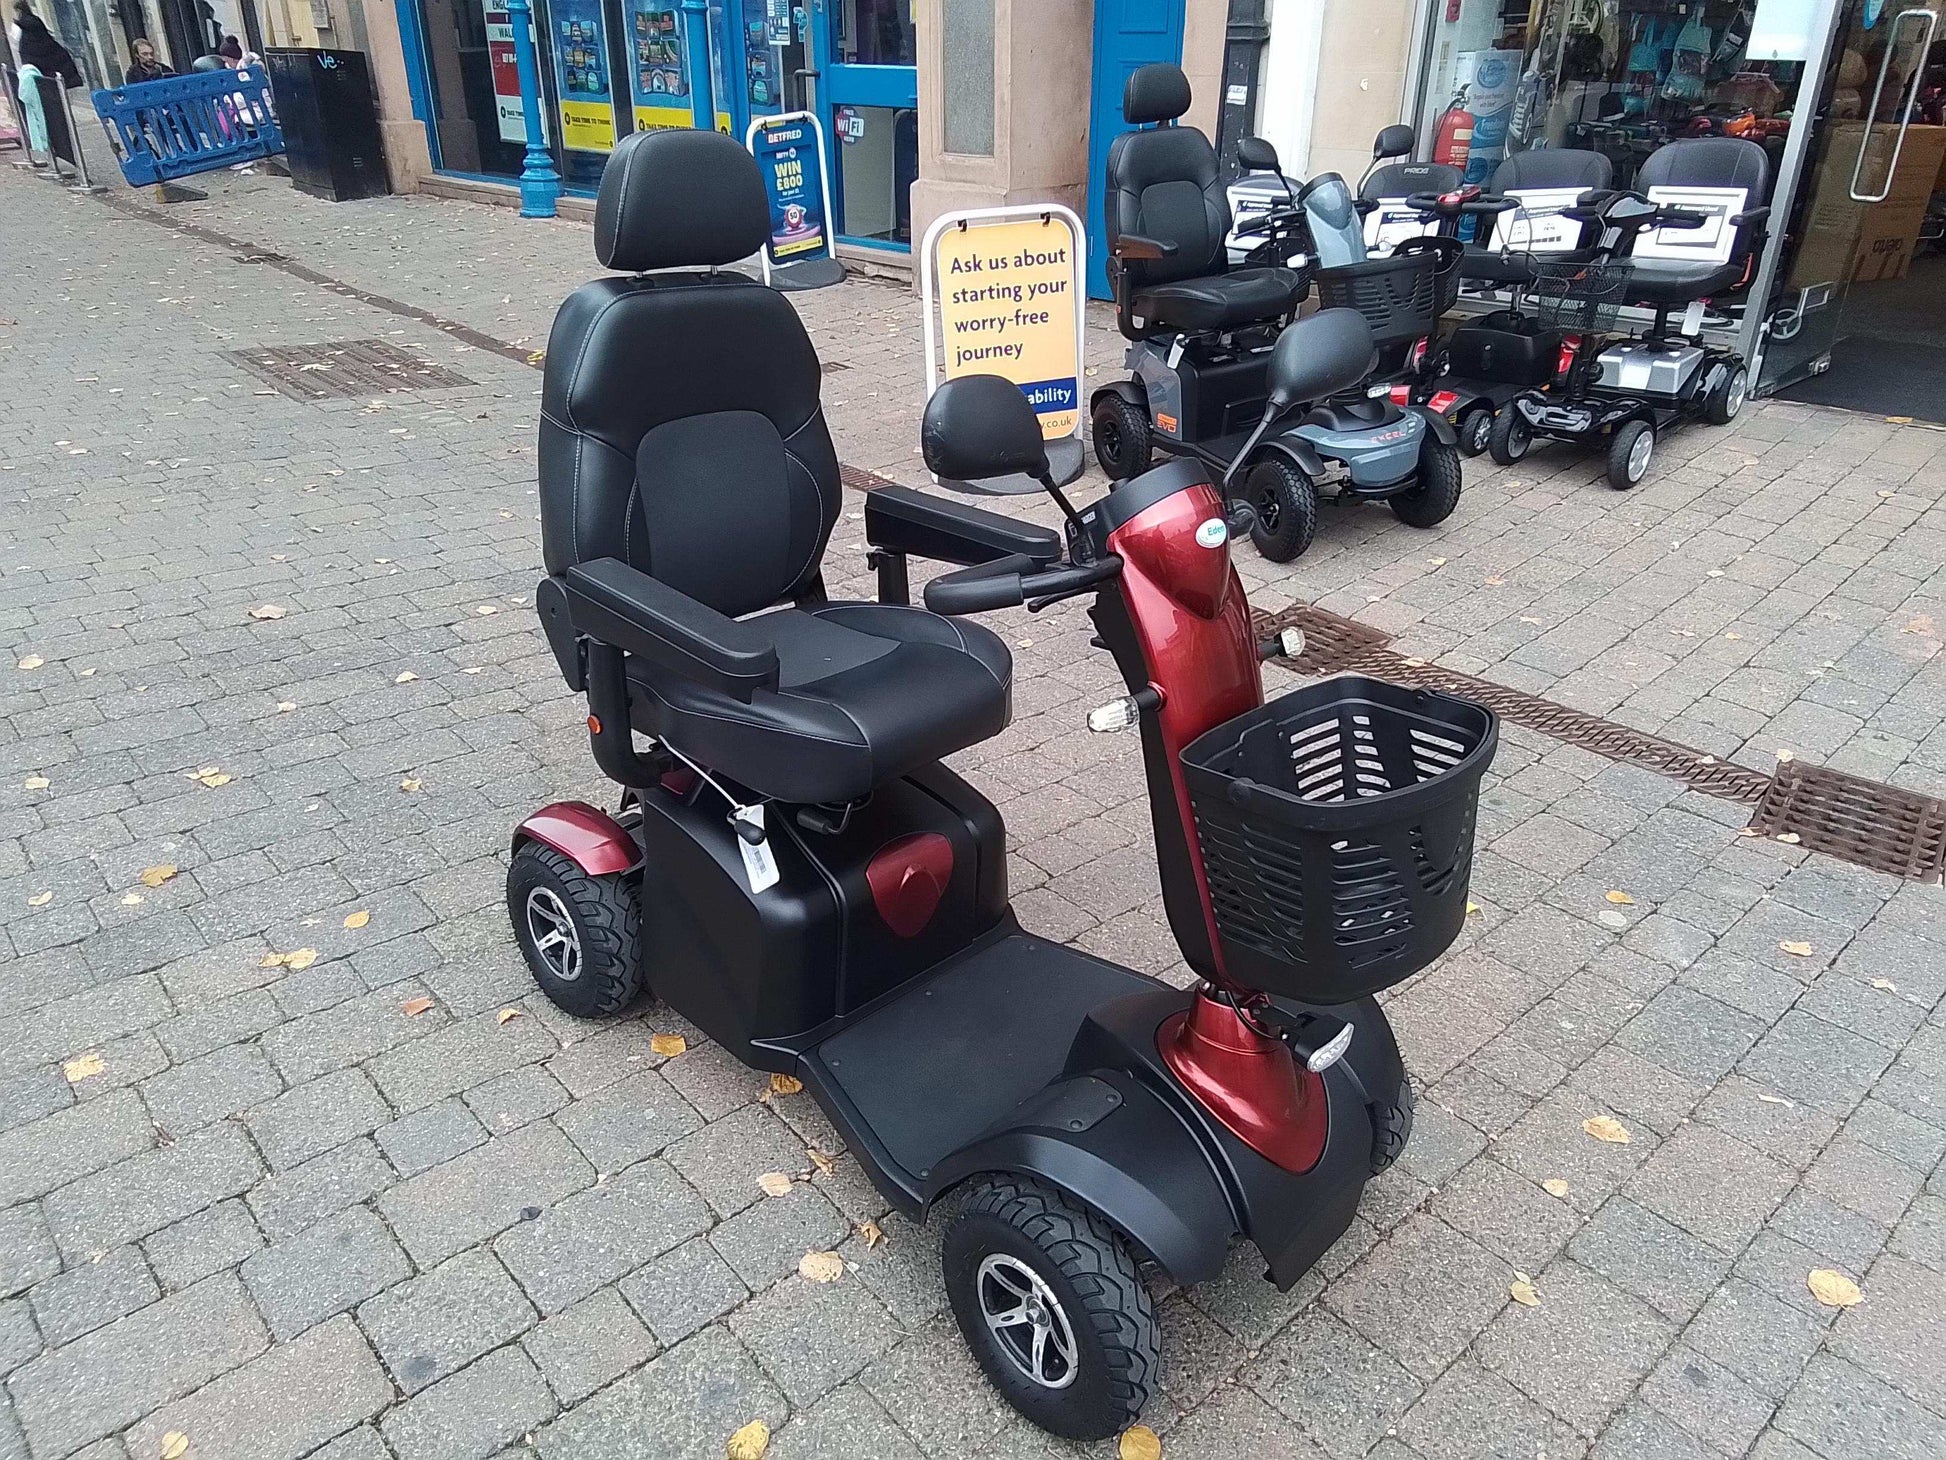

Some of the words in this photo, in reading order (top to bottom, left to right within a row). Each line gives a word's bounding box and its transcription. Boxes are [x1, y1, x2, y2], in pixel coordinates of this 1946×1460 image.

[768, 128, 802, 144] BETFRED
[774, 159, 802, 178] WIN
[1404, 167, 1430, 175] PRIDE
[776, 174, 803, 191] £800
[951, 254, 982, 274] Ask
[989, 257, 1008, 270] us
[1014, 248, 1066, 268] about
[953, 283, 1022, 303] starting
[1028, 280, 1067, 301] your
[955, 309, 1049, 333] worry-free
[957, 343, 1023, 367] journey
[1157, 420, 1176, 433] EVO
[1370, 431, 1406, 443] EXCEL
[1208, 525, 1225, 536] Eden
